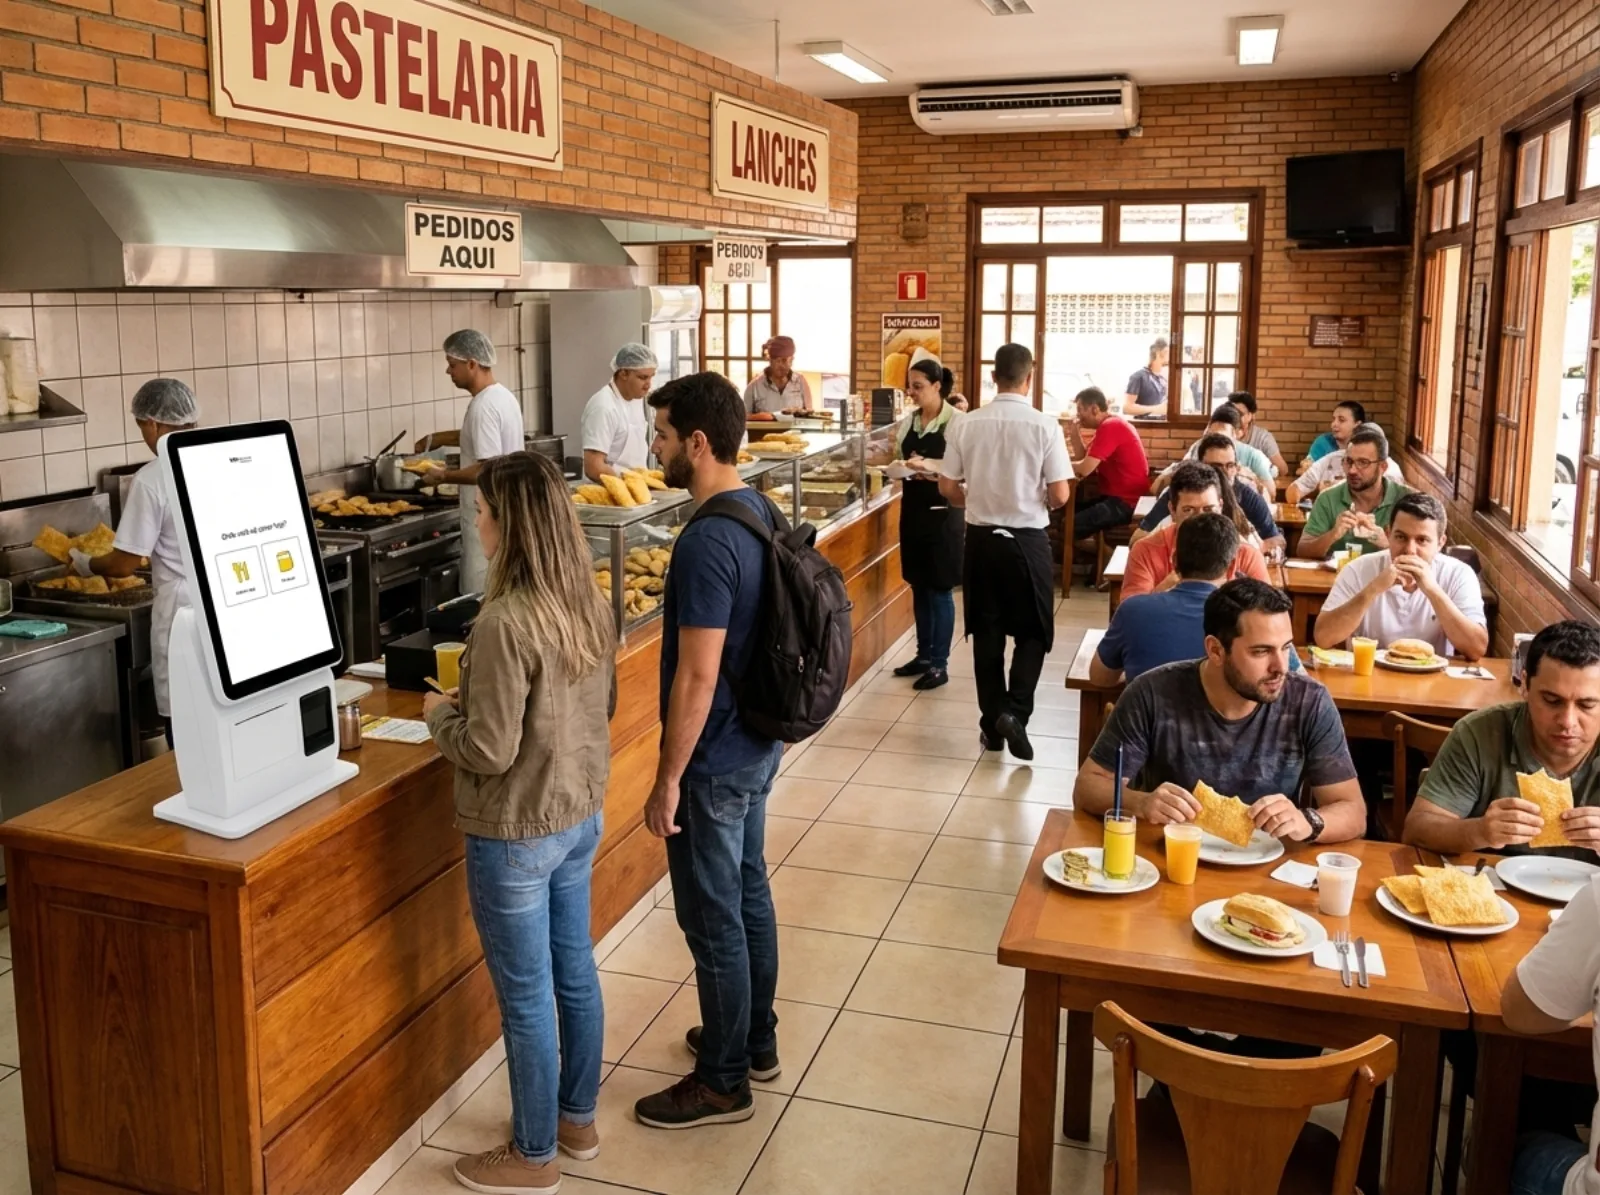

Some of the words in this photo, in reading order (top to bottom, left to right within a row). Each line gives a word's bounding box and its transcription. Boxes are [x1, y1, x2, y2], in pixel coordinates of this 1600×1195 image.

[250, 0, 546, 138] PASTELARIA
[731, 120, 818, 194] LANCHES
[414, 211, 515, 243] PEDIDOS
[439, 244, 495, 269] AQUI
